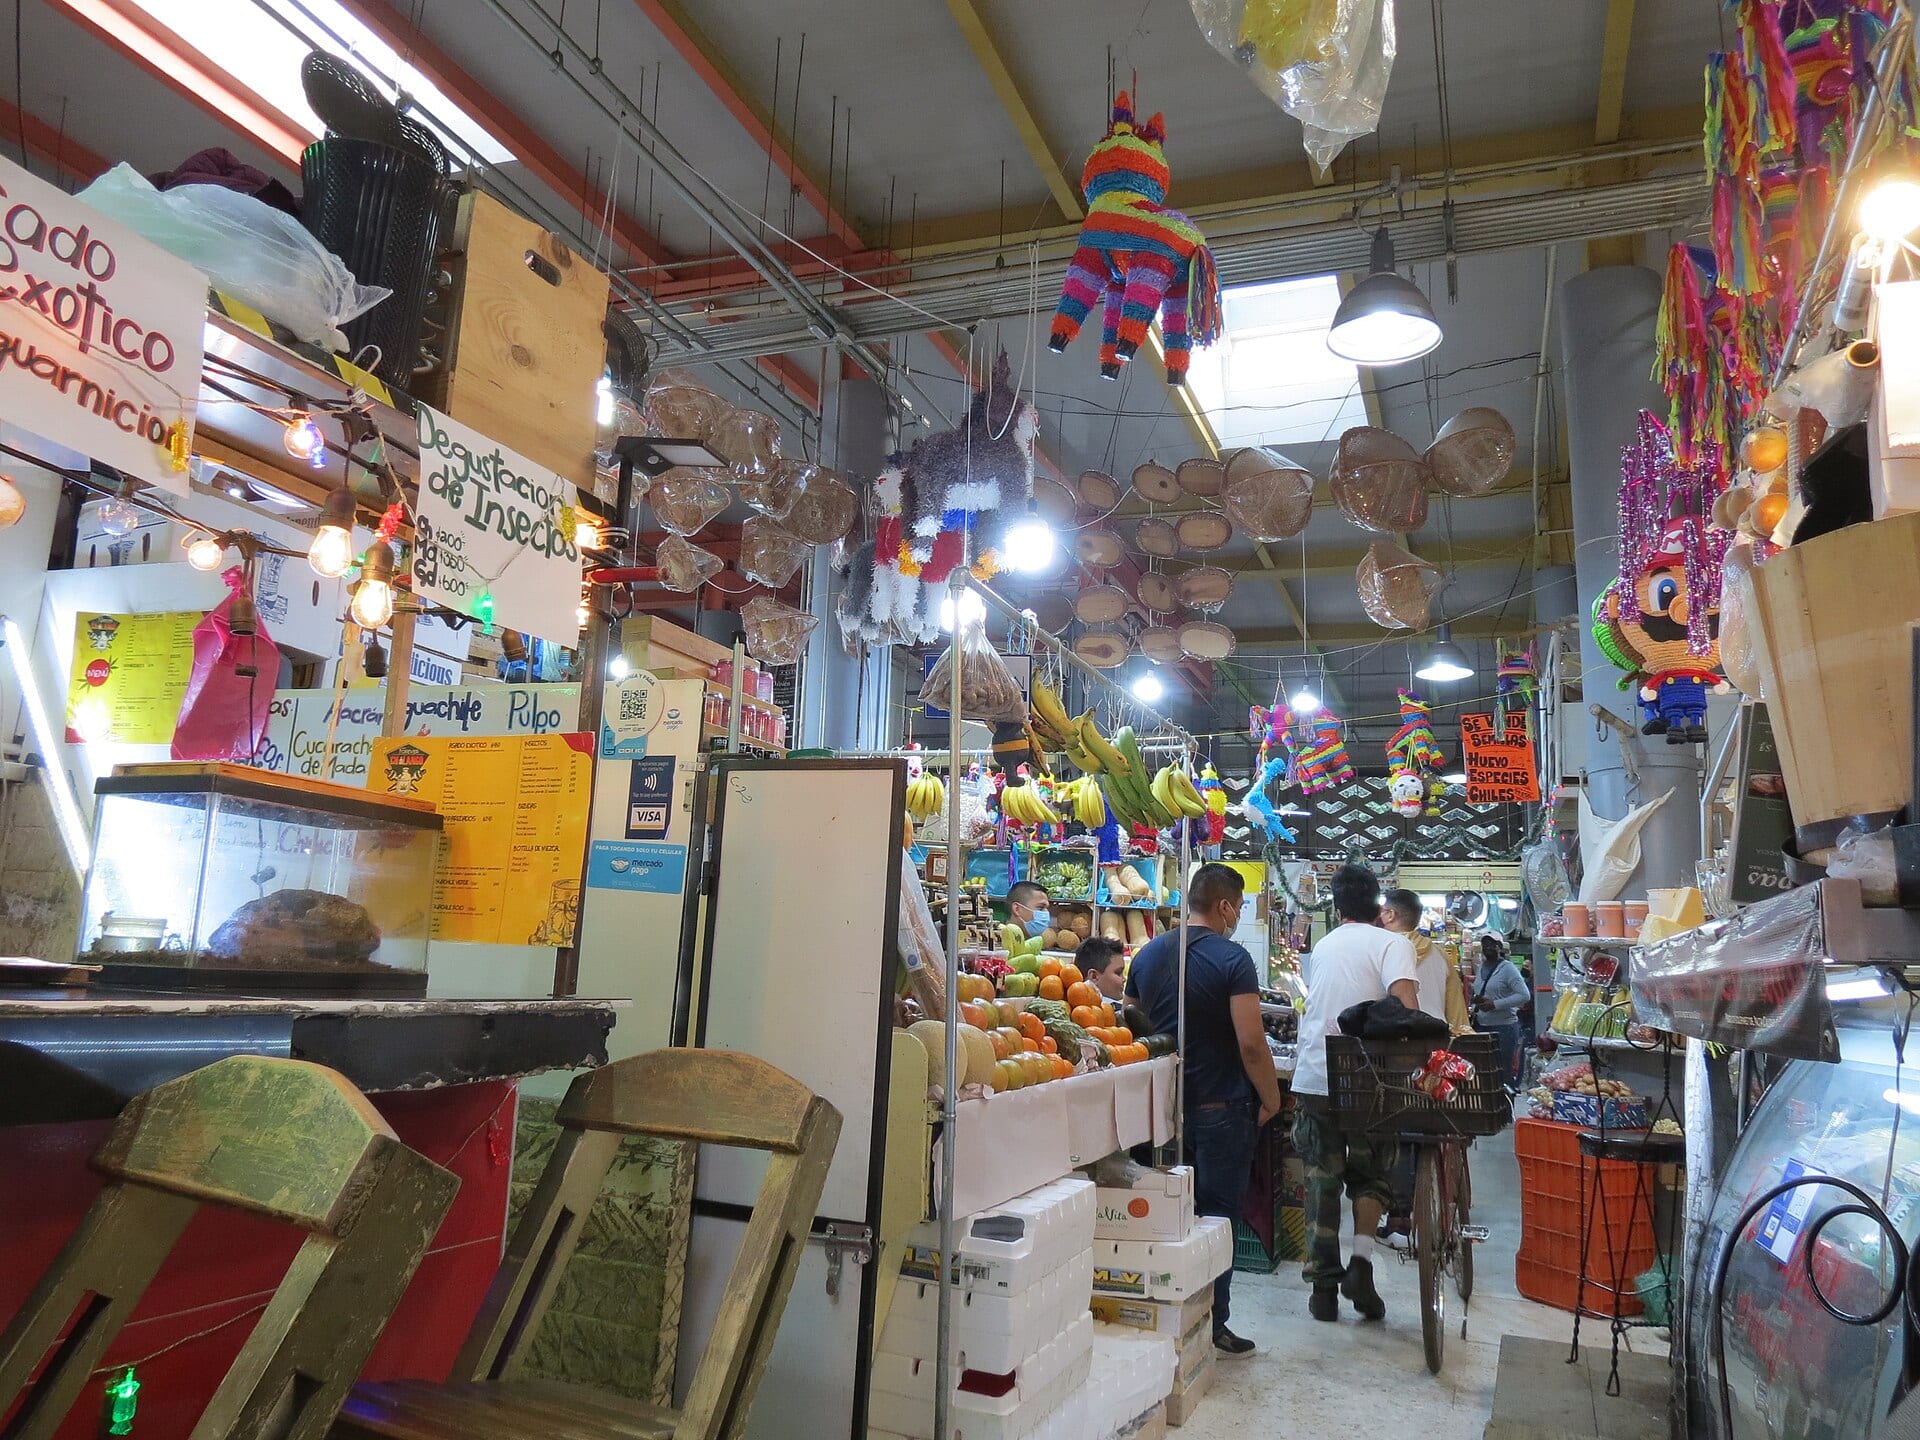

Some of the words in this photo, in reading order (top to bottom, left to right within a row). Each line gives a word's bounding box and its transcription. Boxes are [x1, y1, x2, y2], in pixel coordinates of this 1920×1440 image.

[0, 184, 116, 282] ado
[0, 274, 175, 373] xotico
[429, 465, 464, 510] de
[508, 690, 561, 734] Pulpo
[1469, 769, 1529, 785] ESPECIES
[1469, 786, 1515, 802] CHILES
[637, 811, 661, 822] VISA
[631, 859, 664, 868] mercado
[631, 867, 649, 876] pago
